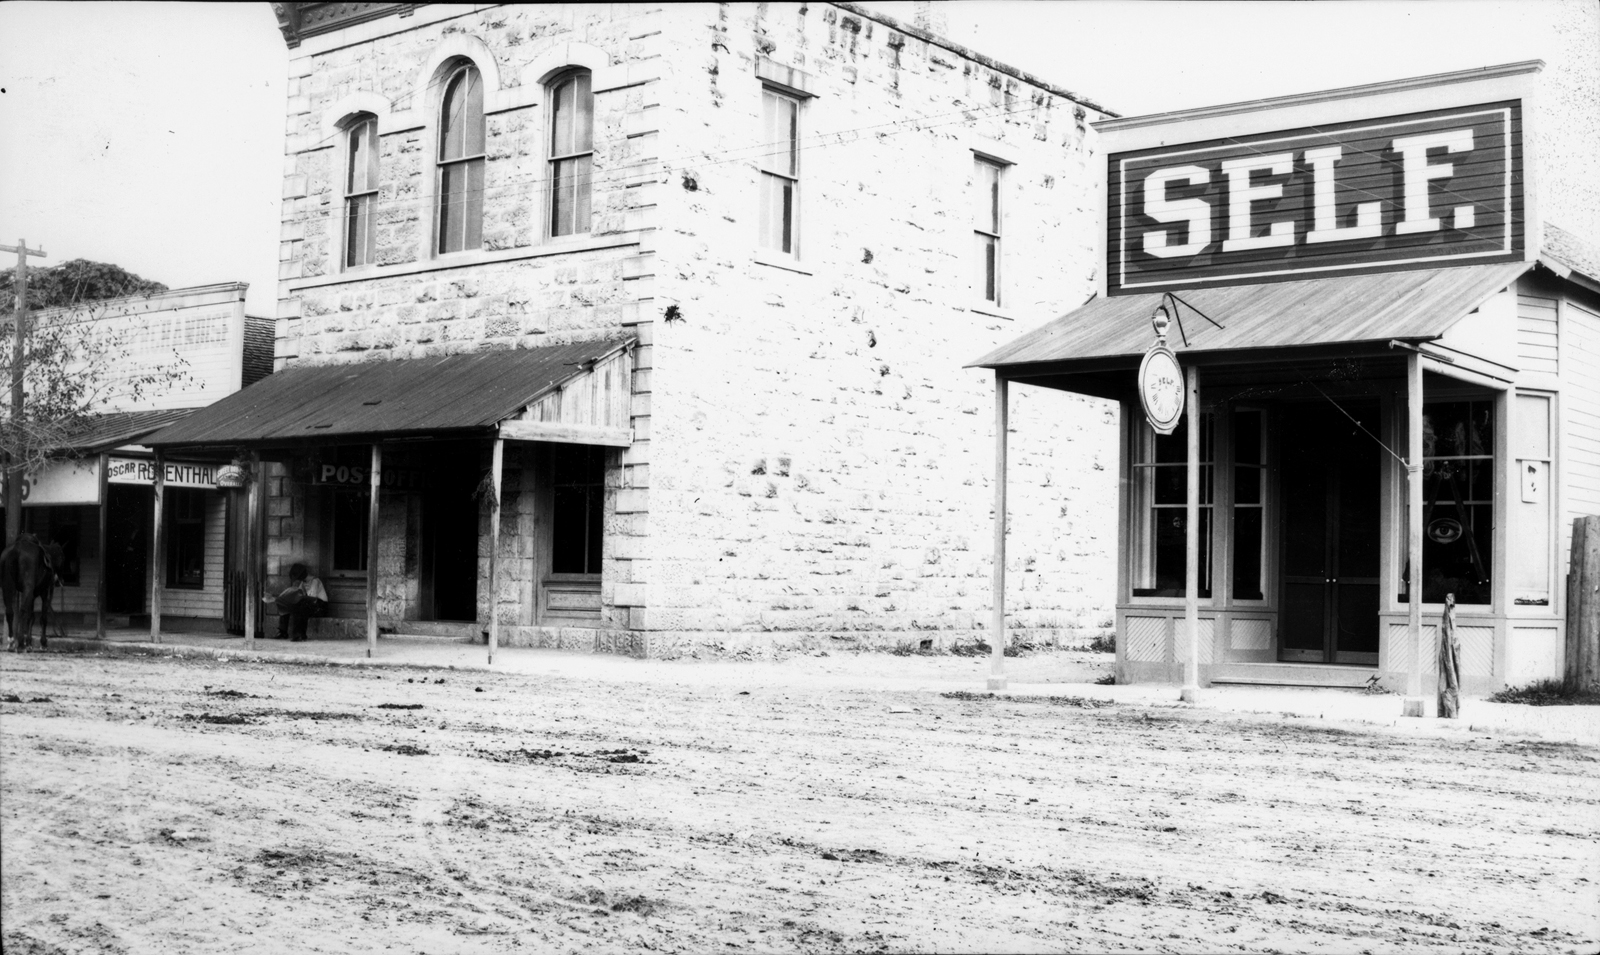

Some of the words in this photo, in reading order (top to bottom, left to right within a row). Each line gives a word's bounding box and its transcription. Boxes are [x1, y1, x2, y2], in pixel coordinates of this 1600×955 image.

[1143, 129, 1475, 259] SELF.
[107, 462, 136, 478] OSCAR
[137, 463, 217, 486] ROENTHAL
